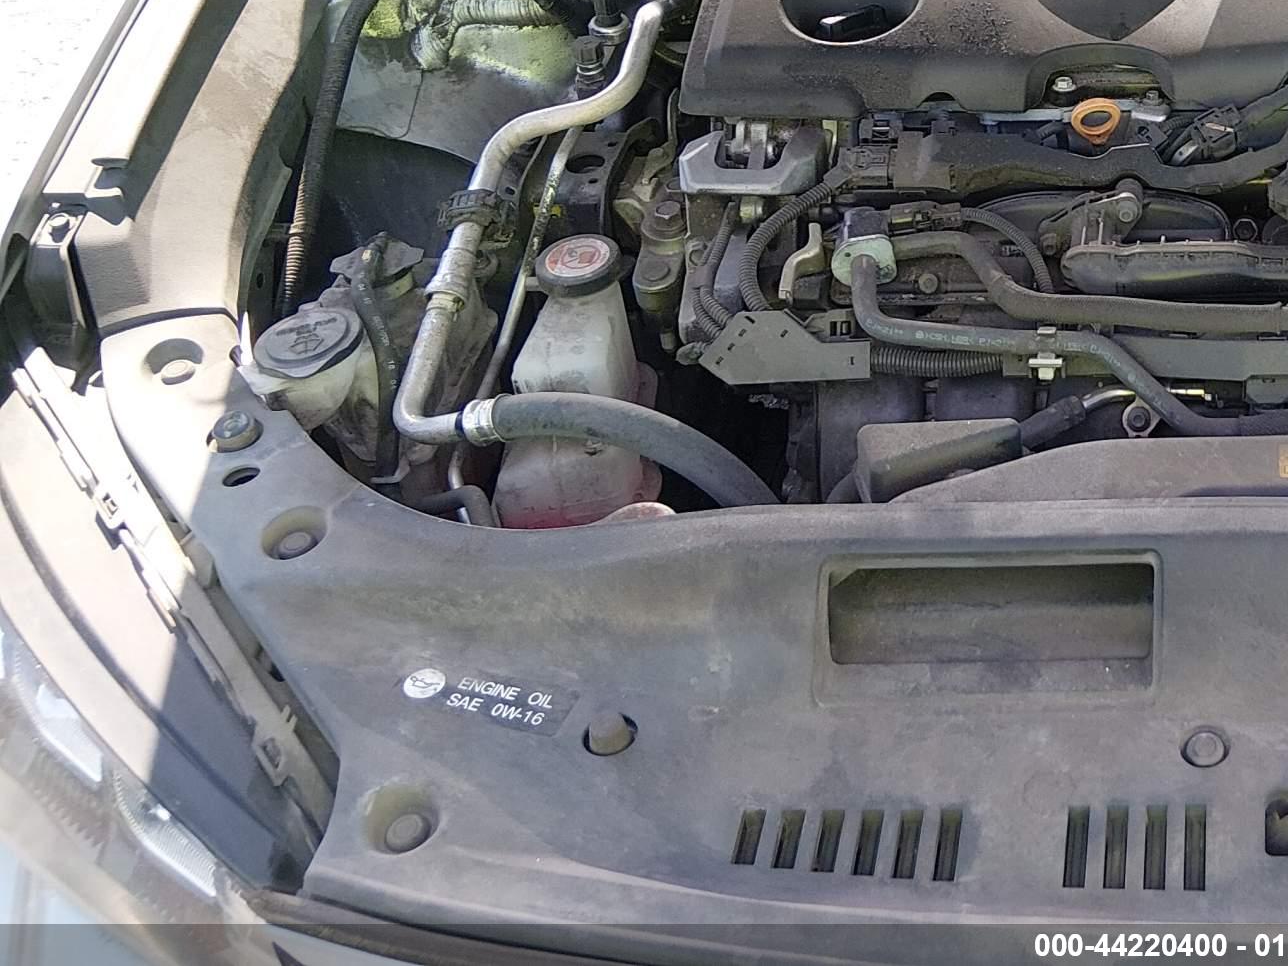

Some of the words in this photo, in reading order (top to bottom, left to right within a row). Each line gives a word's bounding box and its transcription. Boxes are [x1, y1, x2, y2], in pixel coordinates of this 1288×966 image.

[457, 677, 521, 701] ENGINE
[527, 691, 553, 709] OIL
[446, 693, 484, 712] SAE
[491, 703, 545, 726] 0W-16
